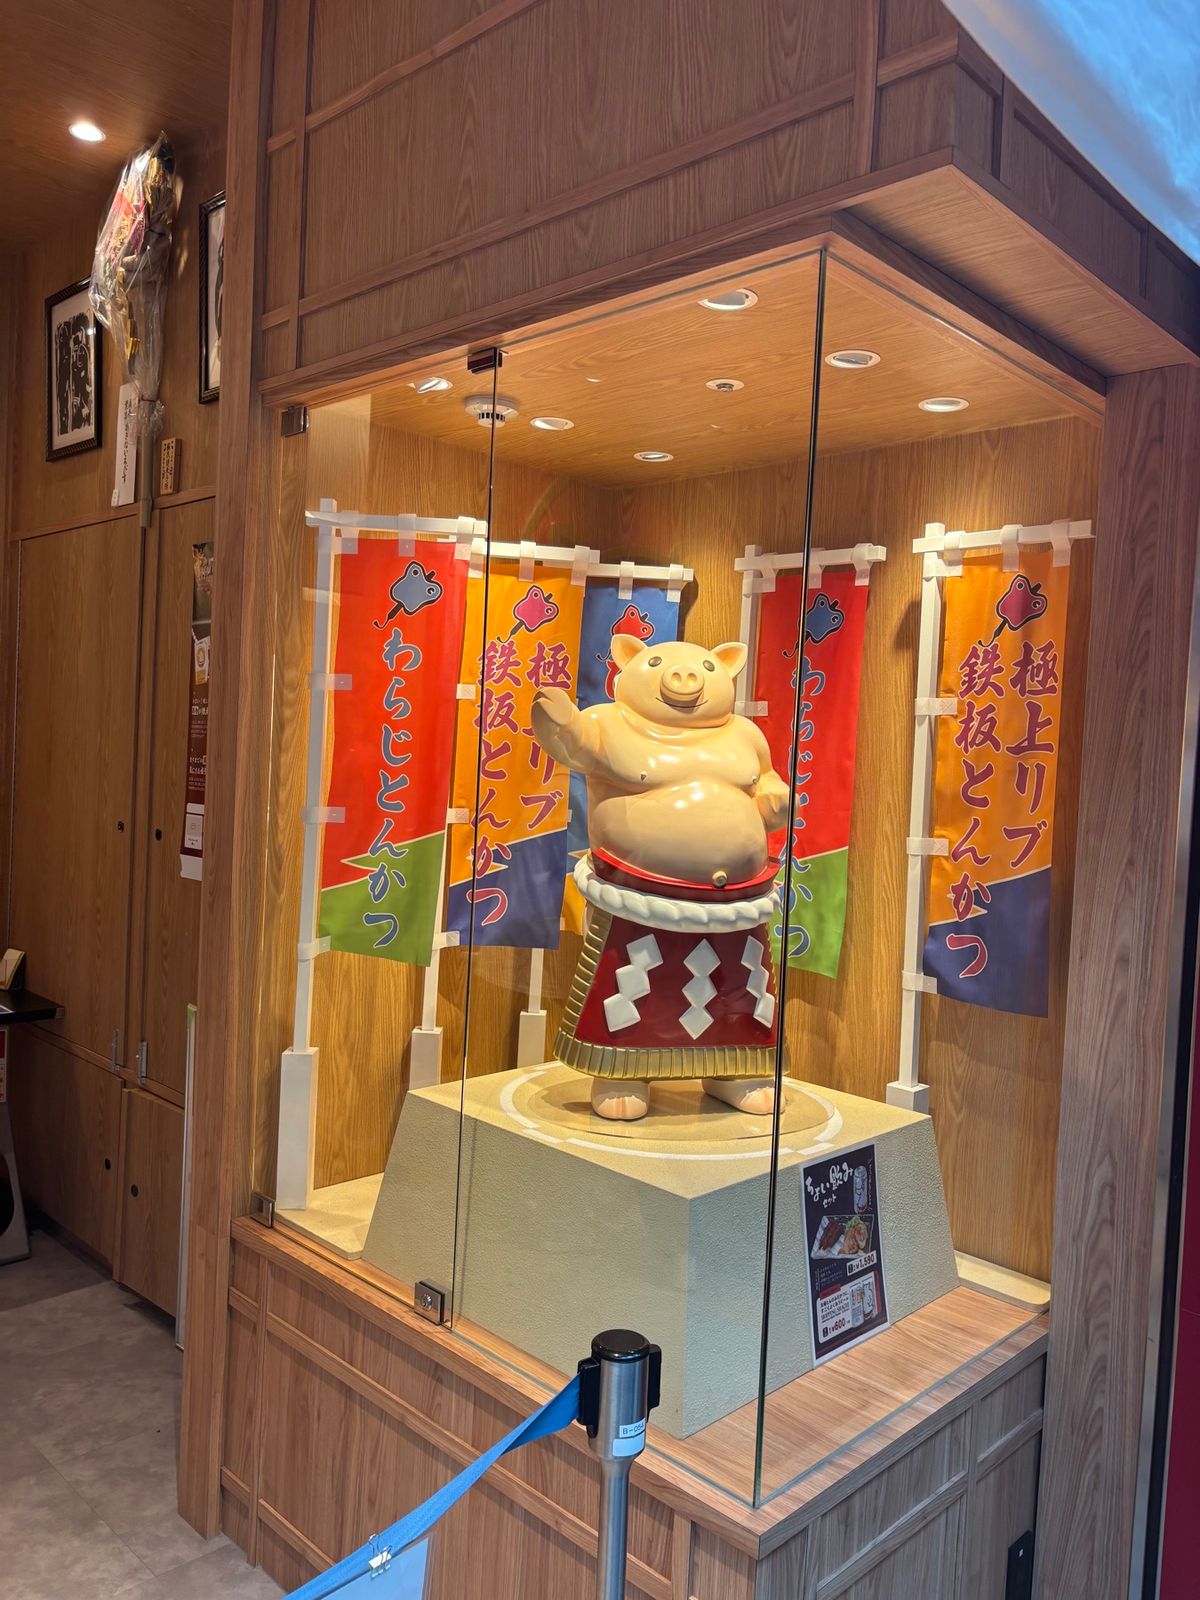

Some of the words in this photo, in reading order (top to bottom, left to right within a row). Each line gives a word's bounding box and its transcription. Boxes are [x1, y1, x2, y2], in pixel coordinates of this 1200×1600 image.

[362, 627, 423, 950] わらじとんかつ
[465, 640, 522, 926] 鉄板とんかつ
[521, 641, 573, 830] 極リブ
[946, 642, 1005, 979] 鉄板とんかつ
[1003, 640, 1060, 869] 極上リブ
